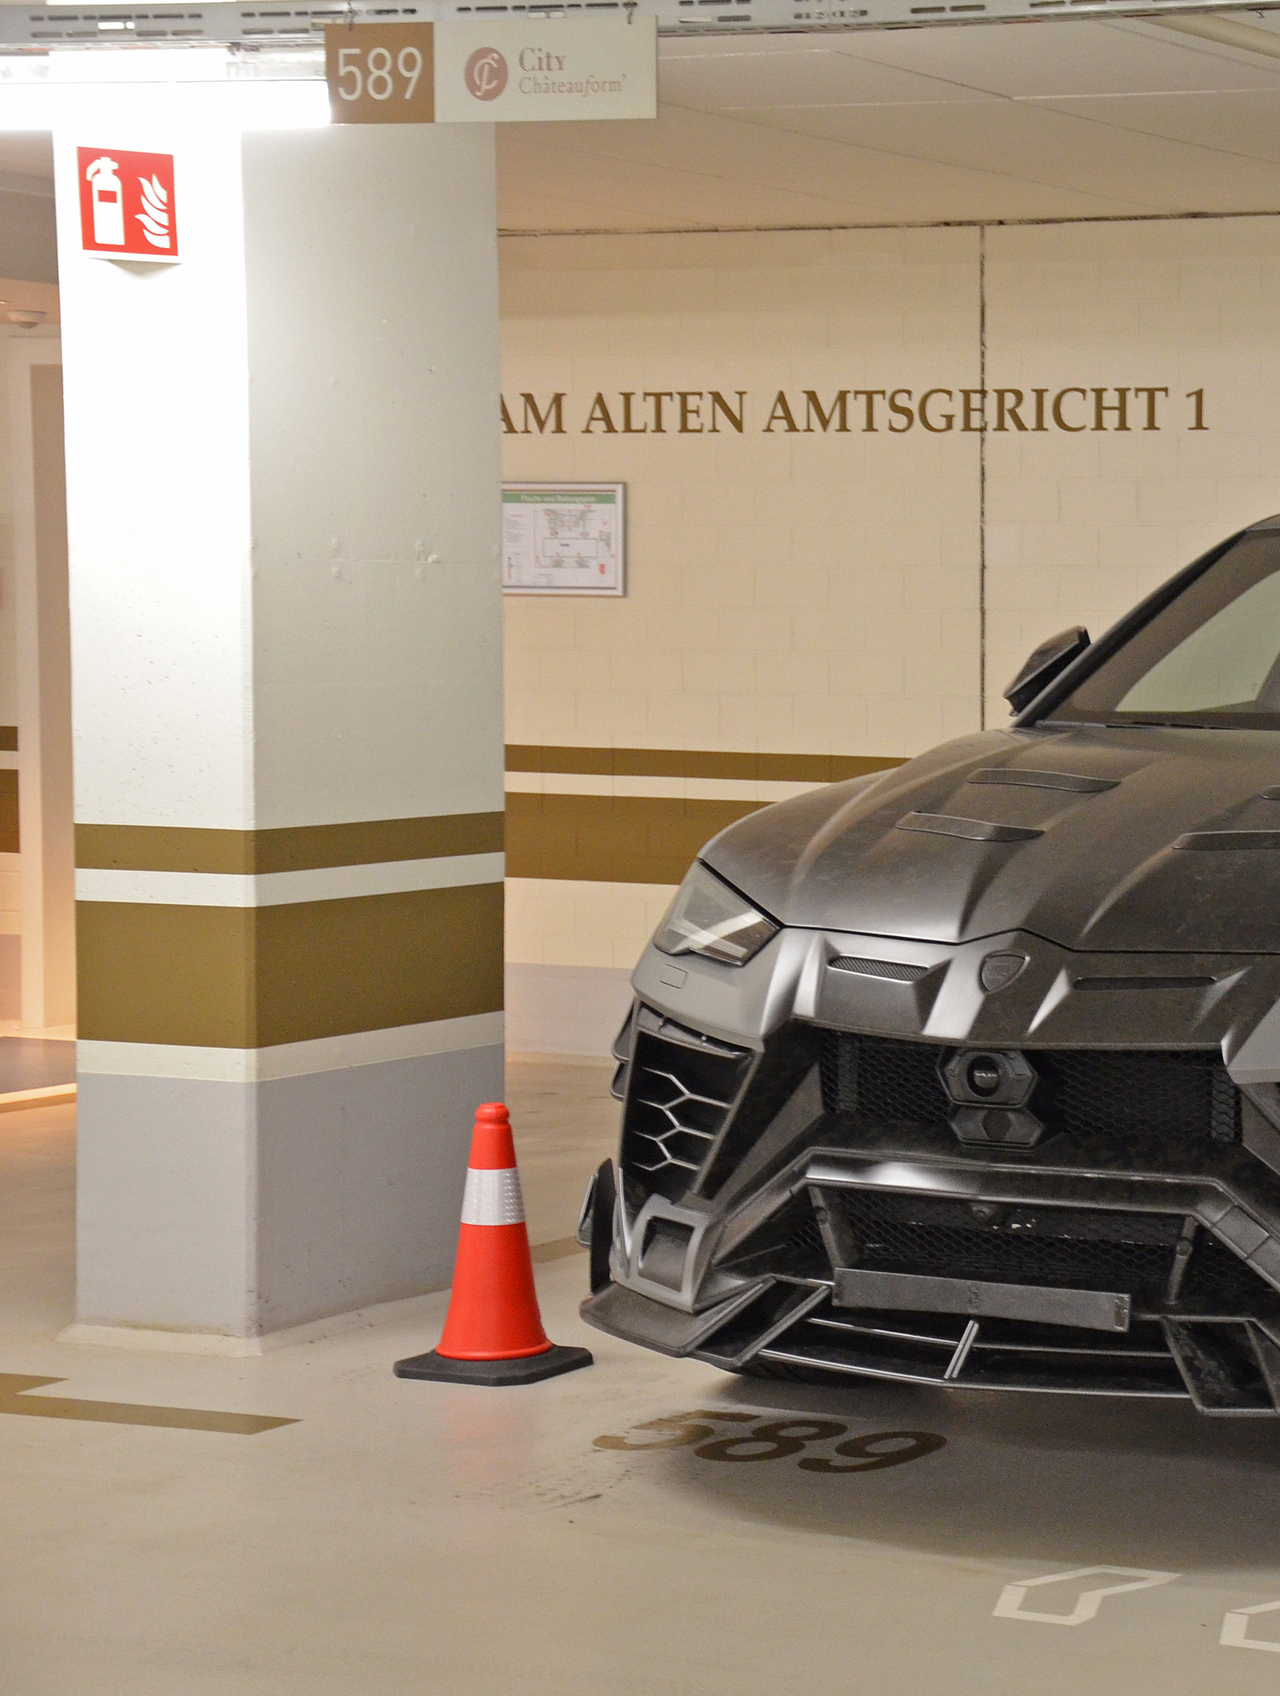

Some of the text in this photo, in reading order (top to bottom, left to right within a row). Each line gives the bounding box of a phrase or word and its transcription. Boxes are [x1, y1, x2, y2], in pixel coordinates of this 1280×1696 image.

[337, 47, 422, 101] 589
[518, 47, 566, 72] City
[581, 391, 747, 434] ALTEN
[762, 387, 1169, 433] AMTSGERICHT
[1186, 388, 1210, 431] 1
[592, 1409, 948, 1474] 589
